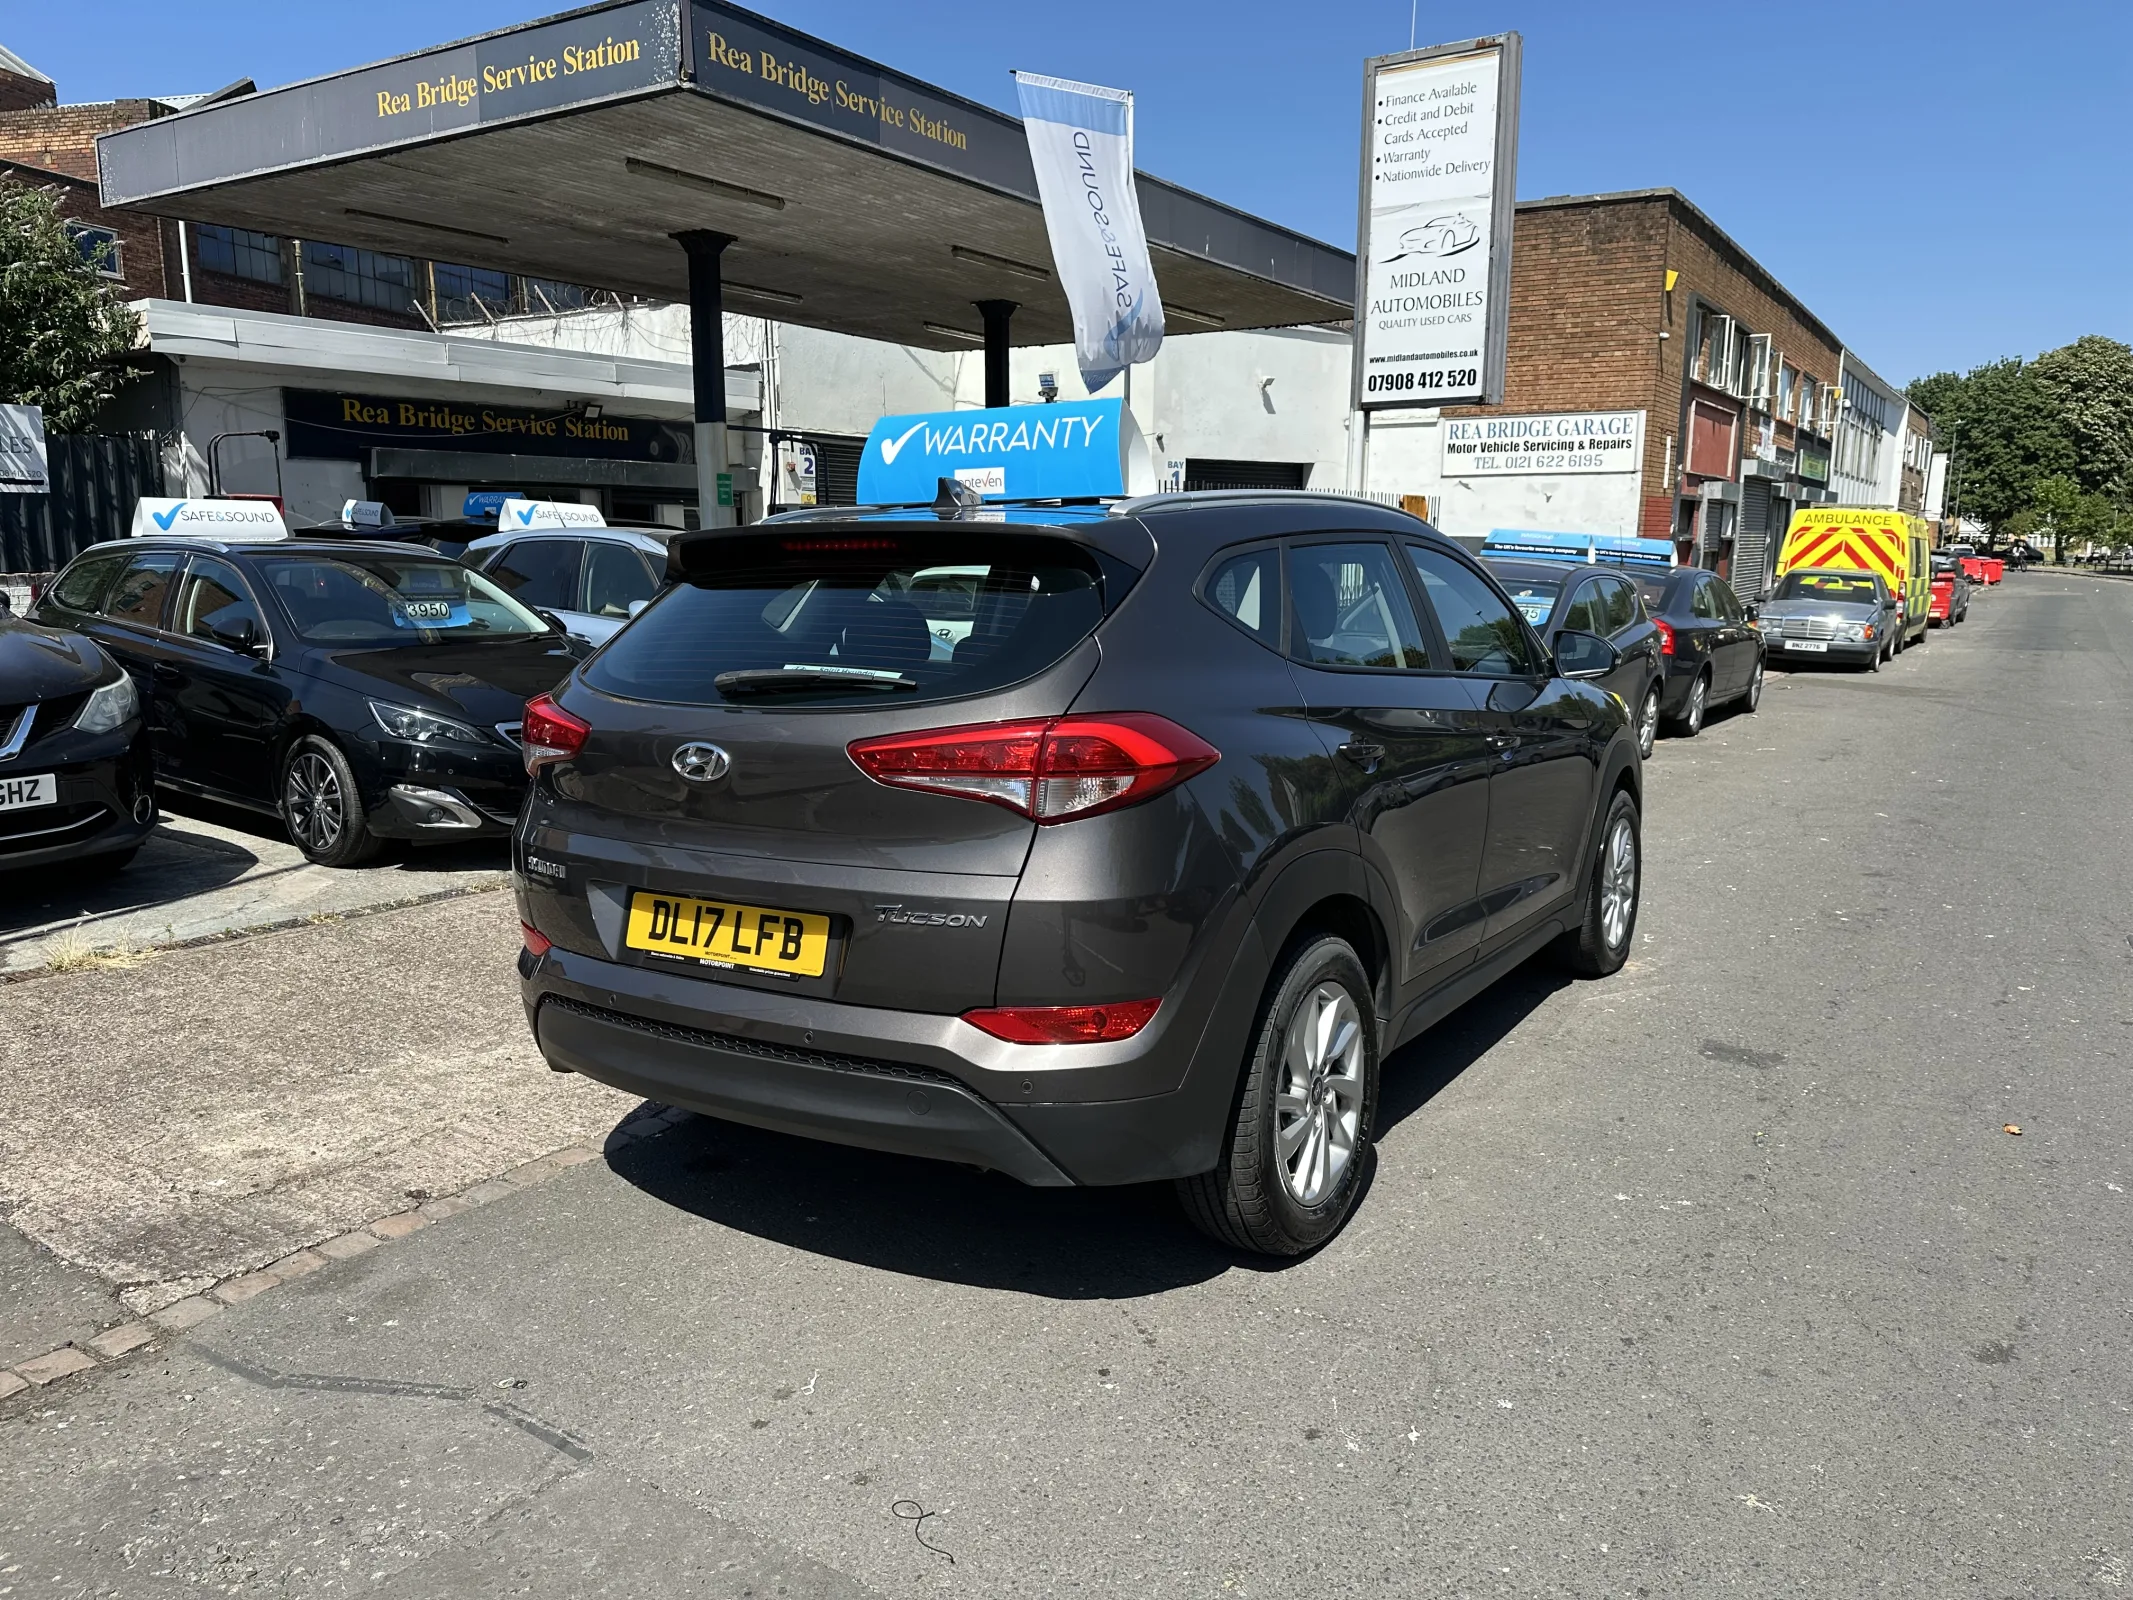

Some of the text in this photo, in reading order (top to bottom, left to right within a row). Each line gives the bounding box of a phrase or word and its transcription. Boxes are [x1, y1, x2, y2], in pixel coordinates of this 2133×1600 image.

[376, 36, 640, 117] Rea Bridge Service Station
[708, 31, 968, 151] Rea Bridge Service Station
[1386, 82, 1477, 107] Finance Available
[1385, 102, 1474, 126] Credit and Debit
[1384, 121, 1468, 145] Cards Accepted
[1383, 149, 1431, 164] Warranty
[1383, 160, 1491, 183] Nationwide Delivery
[1390, 268, 1466, 289] MIDLAND
[1371, 290, 1484, 314] AUTOMOBILES
[1379, 313, 1472, 330] QUALITY USED CARS
[1369, 349, 1478, 364] www.midlandautomobiles.co.uk
[1368, 368, 1477, 392] 07908 412 520
[342, 398, 629, 441] Rea Bridge Service Station
[924, 415, 1104, 456] WARRANTY
[1449, 417, 1634, 440] REA BRIDGE GARAGE
[800, 447, 812, 455] BA
[1447, 438, 1632, 454] Motor Vehicle Servicing & Repairs
[803, 457, 814, 474] 2
[1167, 461, 1185, 469] BAY
[1474, 454, 1603, 469] TEL. 0121 622 6195
[28, 470, 42, 478] 520
[1171, 470, 1180, 488] 1
[180, 510, 275, 524] SAFE&SOUND
[352, 507, 379, 517] SAFE&SOUND
[535, 509, 600, 524] SAFE&SOUND
[1803, 513, 1892, 526] AMBULANCE
[648, 900, 804, 961] DL17 LFB
[700, 958, 735, 969] MOTORPOINT
